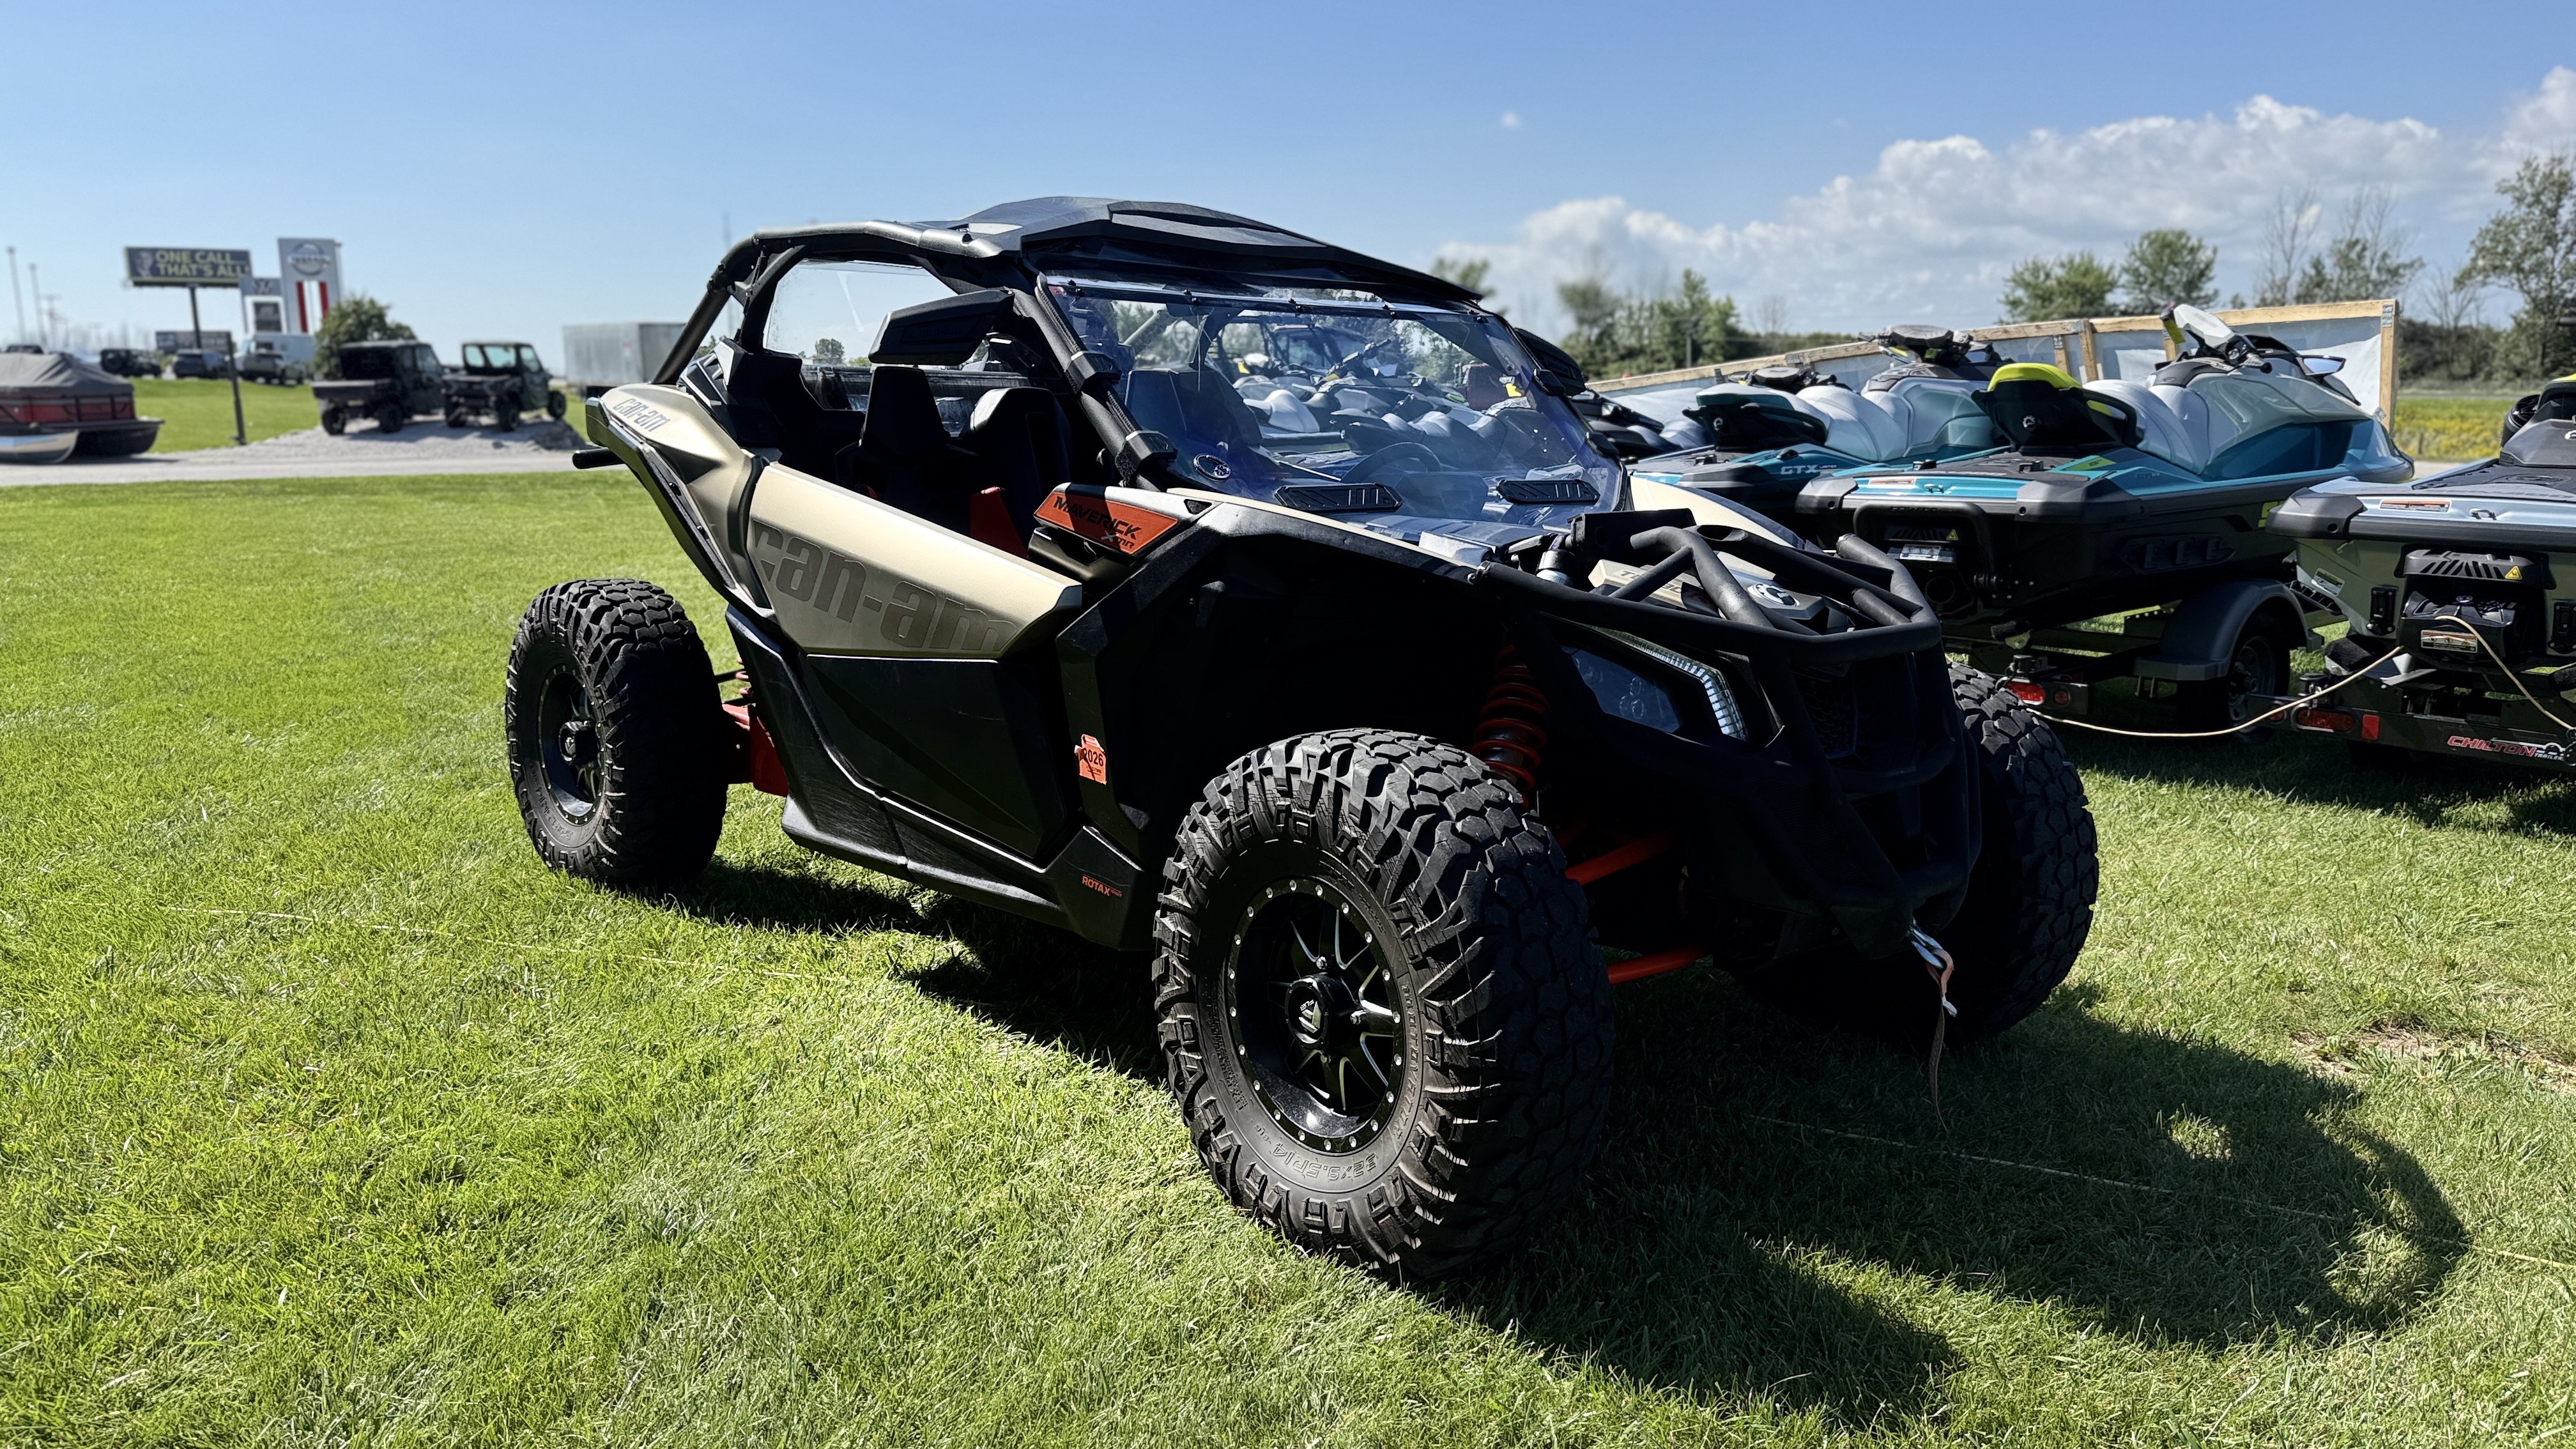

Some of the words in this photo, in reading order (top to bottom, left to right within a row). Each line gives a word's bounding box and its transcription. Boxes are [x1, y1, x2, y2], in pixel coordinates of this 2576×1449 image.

[156, 250, 191, 263] ONE
[157, 263, 214, 277] THAT'S
[613, 398, 671, 432] can-am
[1781, 464, 1819, 475] GTX
[1053, 496, 1142, 540] MAVERICK
[2447, 735, 2536, 757] CHILTON
[2534, 753, 2564, 762] TRAILER
[1082, 875, 1110, 896] ROTAX
